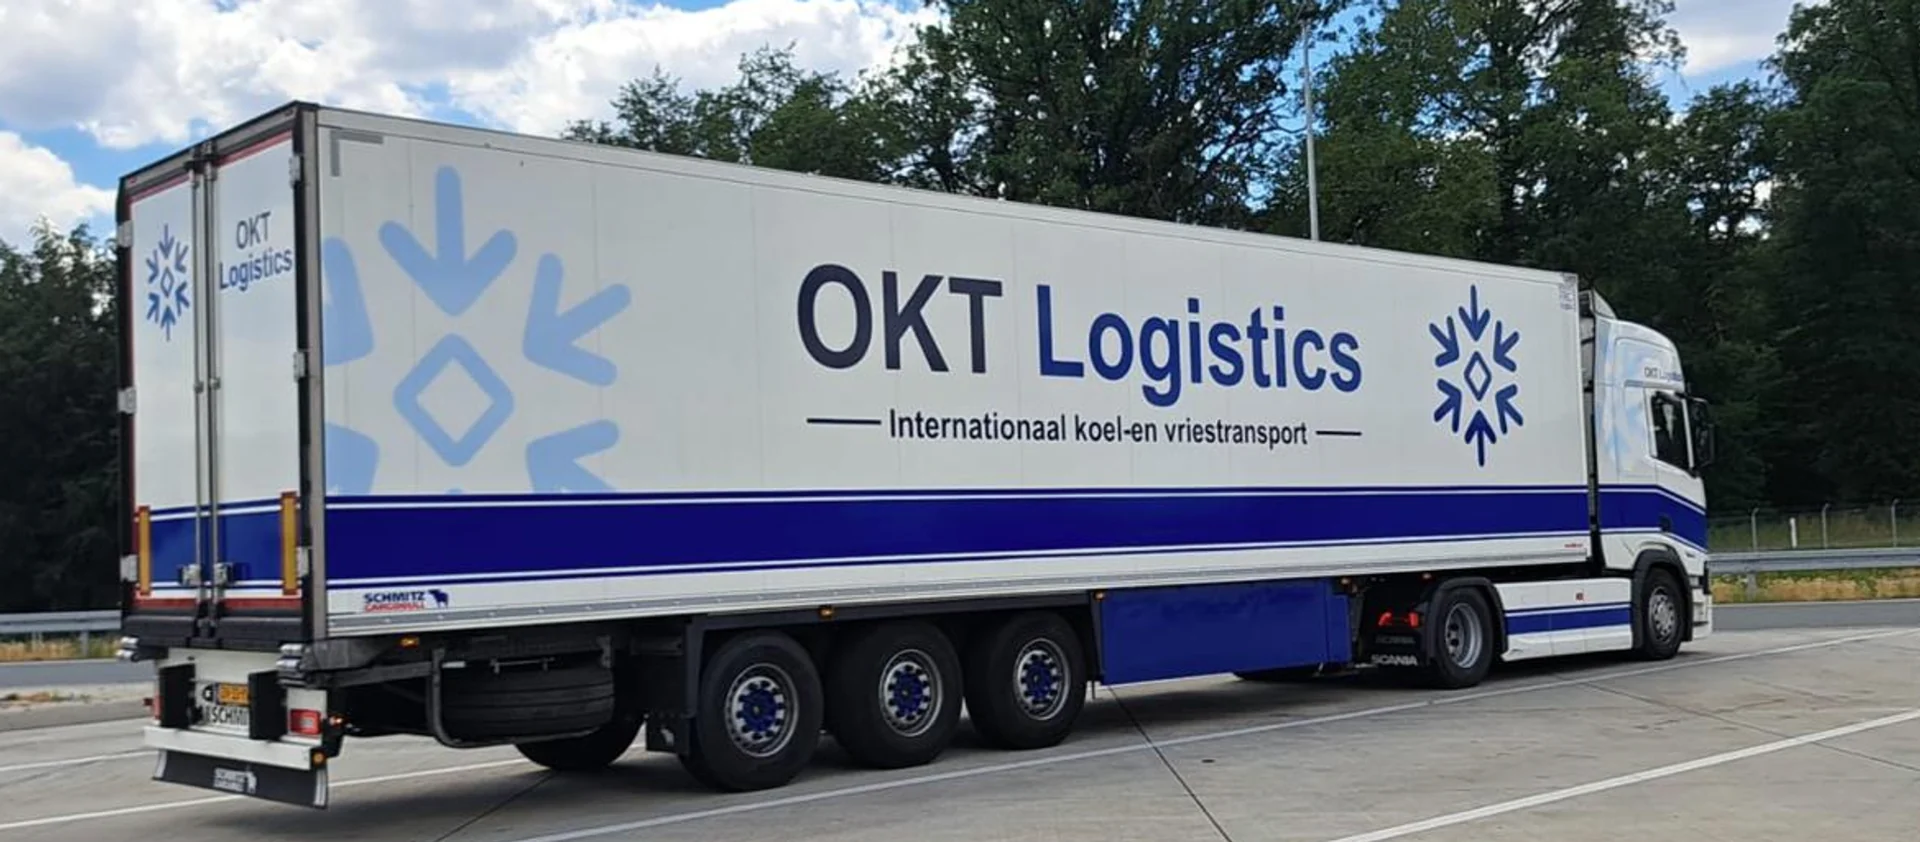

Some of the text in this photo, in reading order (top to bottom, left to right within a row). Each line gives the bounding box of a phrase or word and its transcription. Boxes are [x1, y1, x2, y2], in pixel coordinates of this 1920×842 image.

[236, 211, 271, 249] OKT
[219, 248, 293, 292] Logistics
[797, 263, 1362, 407] OKT Logistics
[889, 408, 1308, 450] Internationaal koel-en vriestransport
[364, 591, 425, 604] SCHMITZ
[1371, 654, 1418, 667] SCANIA
